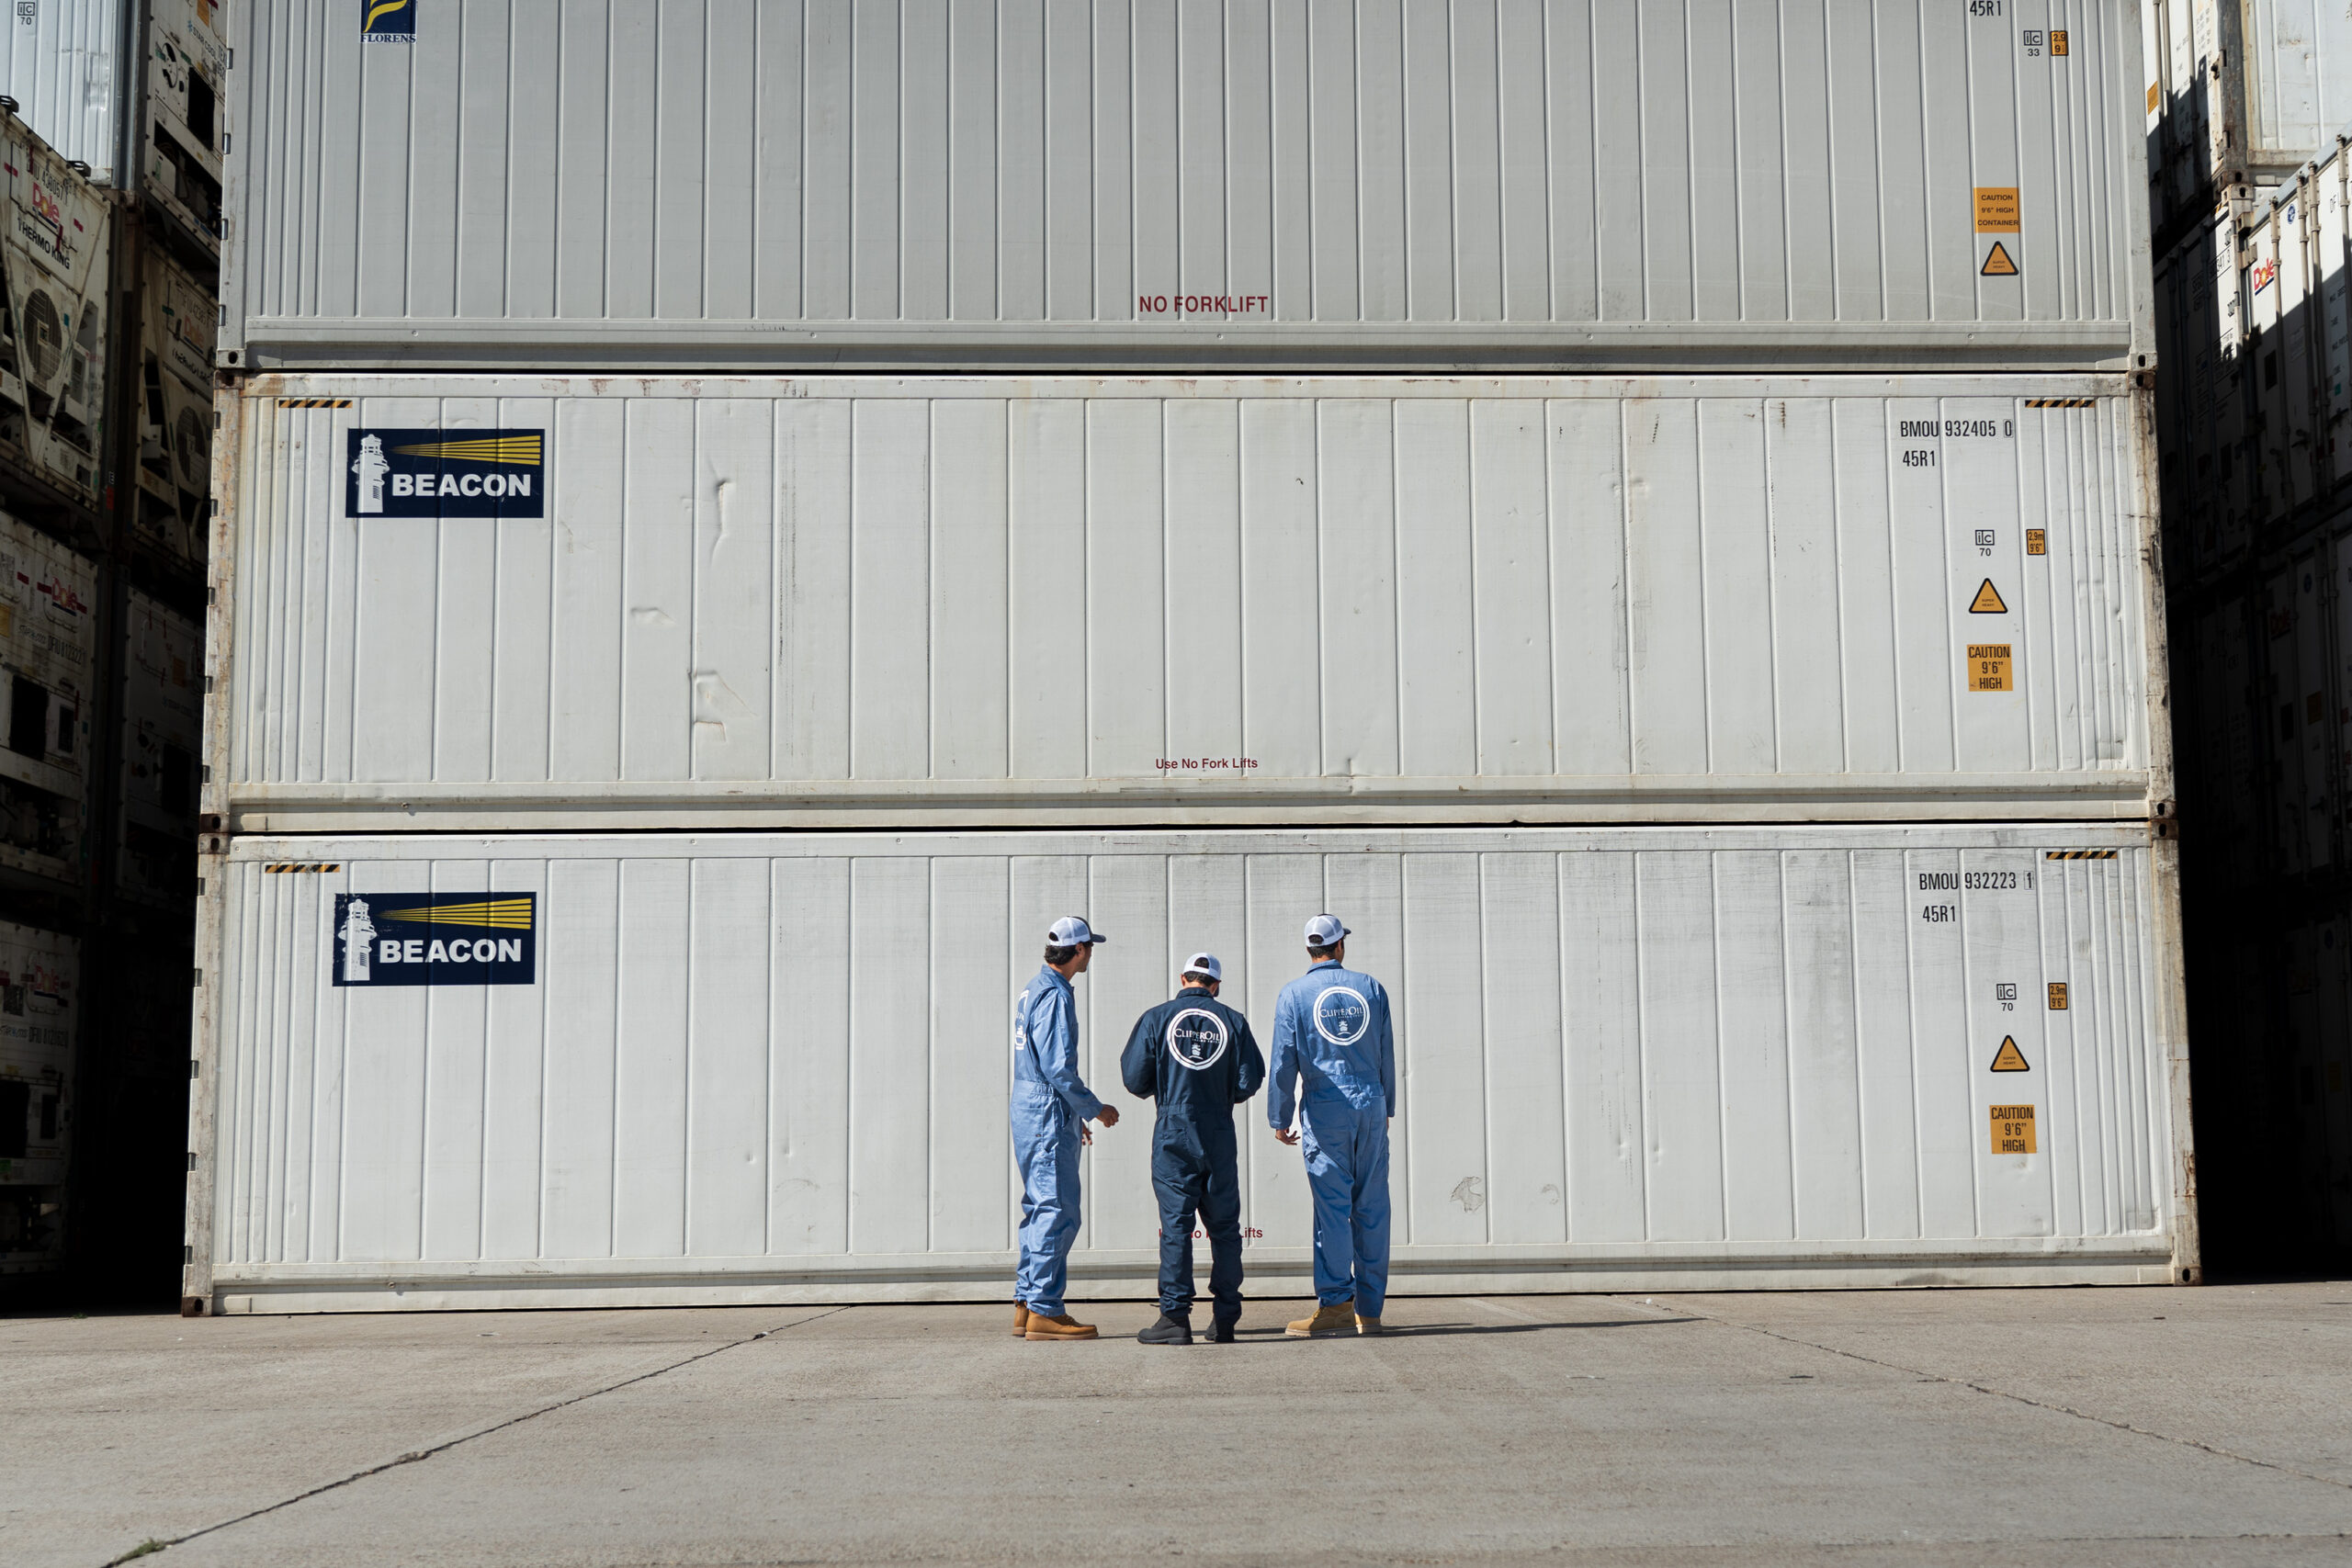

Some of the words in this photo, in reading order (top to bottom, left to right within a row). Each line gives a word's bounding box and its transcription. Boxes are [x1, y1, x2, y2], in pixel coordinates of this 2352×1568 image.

[1970, 0, 2001, 16] 45R1
[20, 17, 32, 26] 70
[360, 34, 416, 43] FLORENS
[33, 182, 61, 223] Dole
[17, 217, 51, 254] THERMO
[51, 248, 71, 270] KING
[1139, 295, 1168, 312] NO
[1174, 295, 1269, 312] FORKLIFT
[1900, 421, 1939, 437] BMOU
[1945, 420, 1996, 437] 932405
[1903, 450, 1935, 467] 45R1
[392, 473, 531, 497] BEACON
[1979, 548, 1992, 557] 70
[52, 577, 78, 610] Dole
[1968, 646, 2010, 659] CAUTION
[1979, 677, 2002, 689] HIGH
[1156, 758, 1178, 769] Use
[1182, 758, 1198, 769] No
[1202, 758, 1228, 769] Fork
[1232, 758, 1258, 769] Lifts
[1919, 873, 1959, 890] BMOU
[1964, 872, 2017, 889] 932223
[1922, 905, 1956, 922] 45R1
[379, 939, 522, 963] BEACON
[2001, 1002, 2014, 1011] 70
[1991, 1107, 2033, 1120] CAUTION
[2002, 1139, 2026, 1152] HIGH
[1240, 1227, 1263, 1238] ifts
